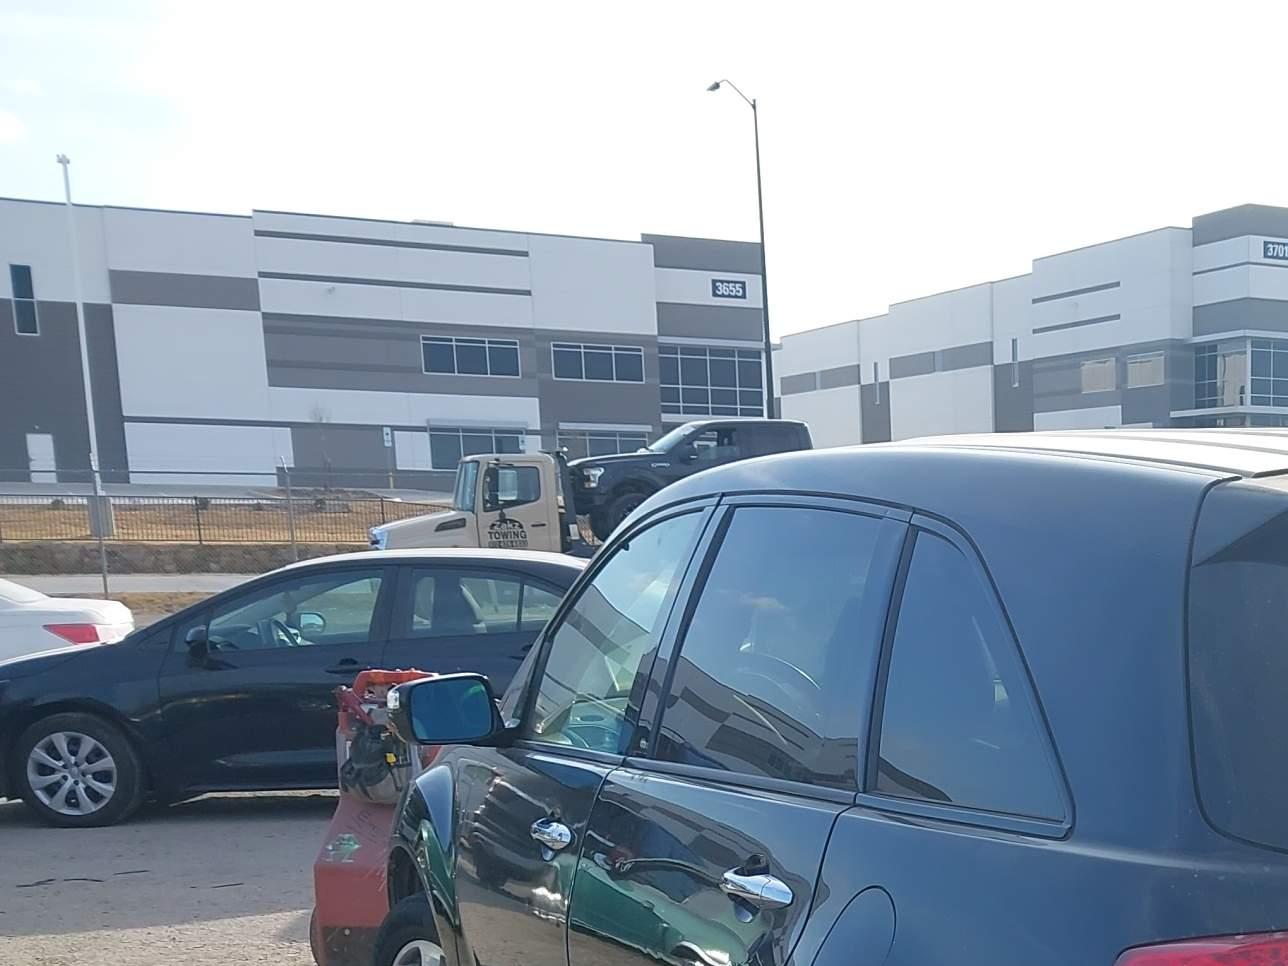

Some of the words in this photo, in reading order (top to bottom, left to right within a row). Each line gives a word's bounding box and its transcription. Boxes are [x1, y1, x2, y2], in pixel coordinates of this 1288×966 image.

[1266, 243, 1288, 257] 3701
[715, 282, 743, 296] 3655
[487, 530, 527, 540] TOWING
